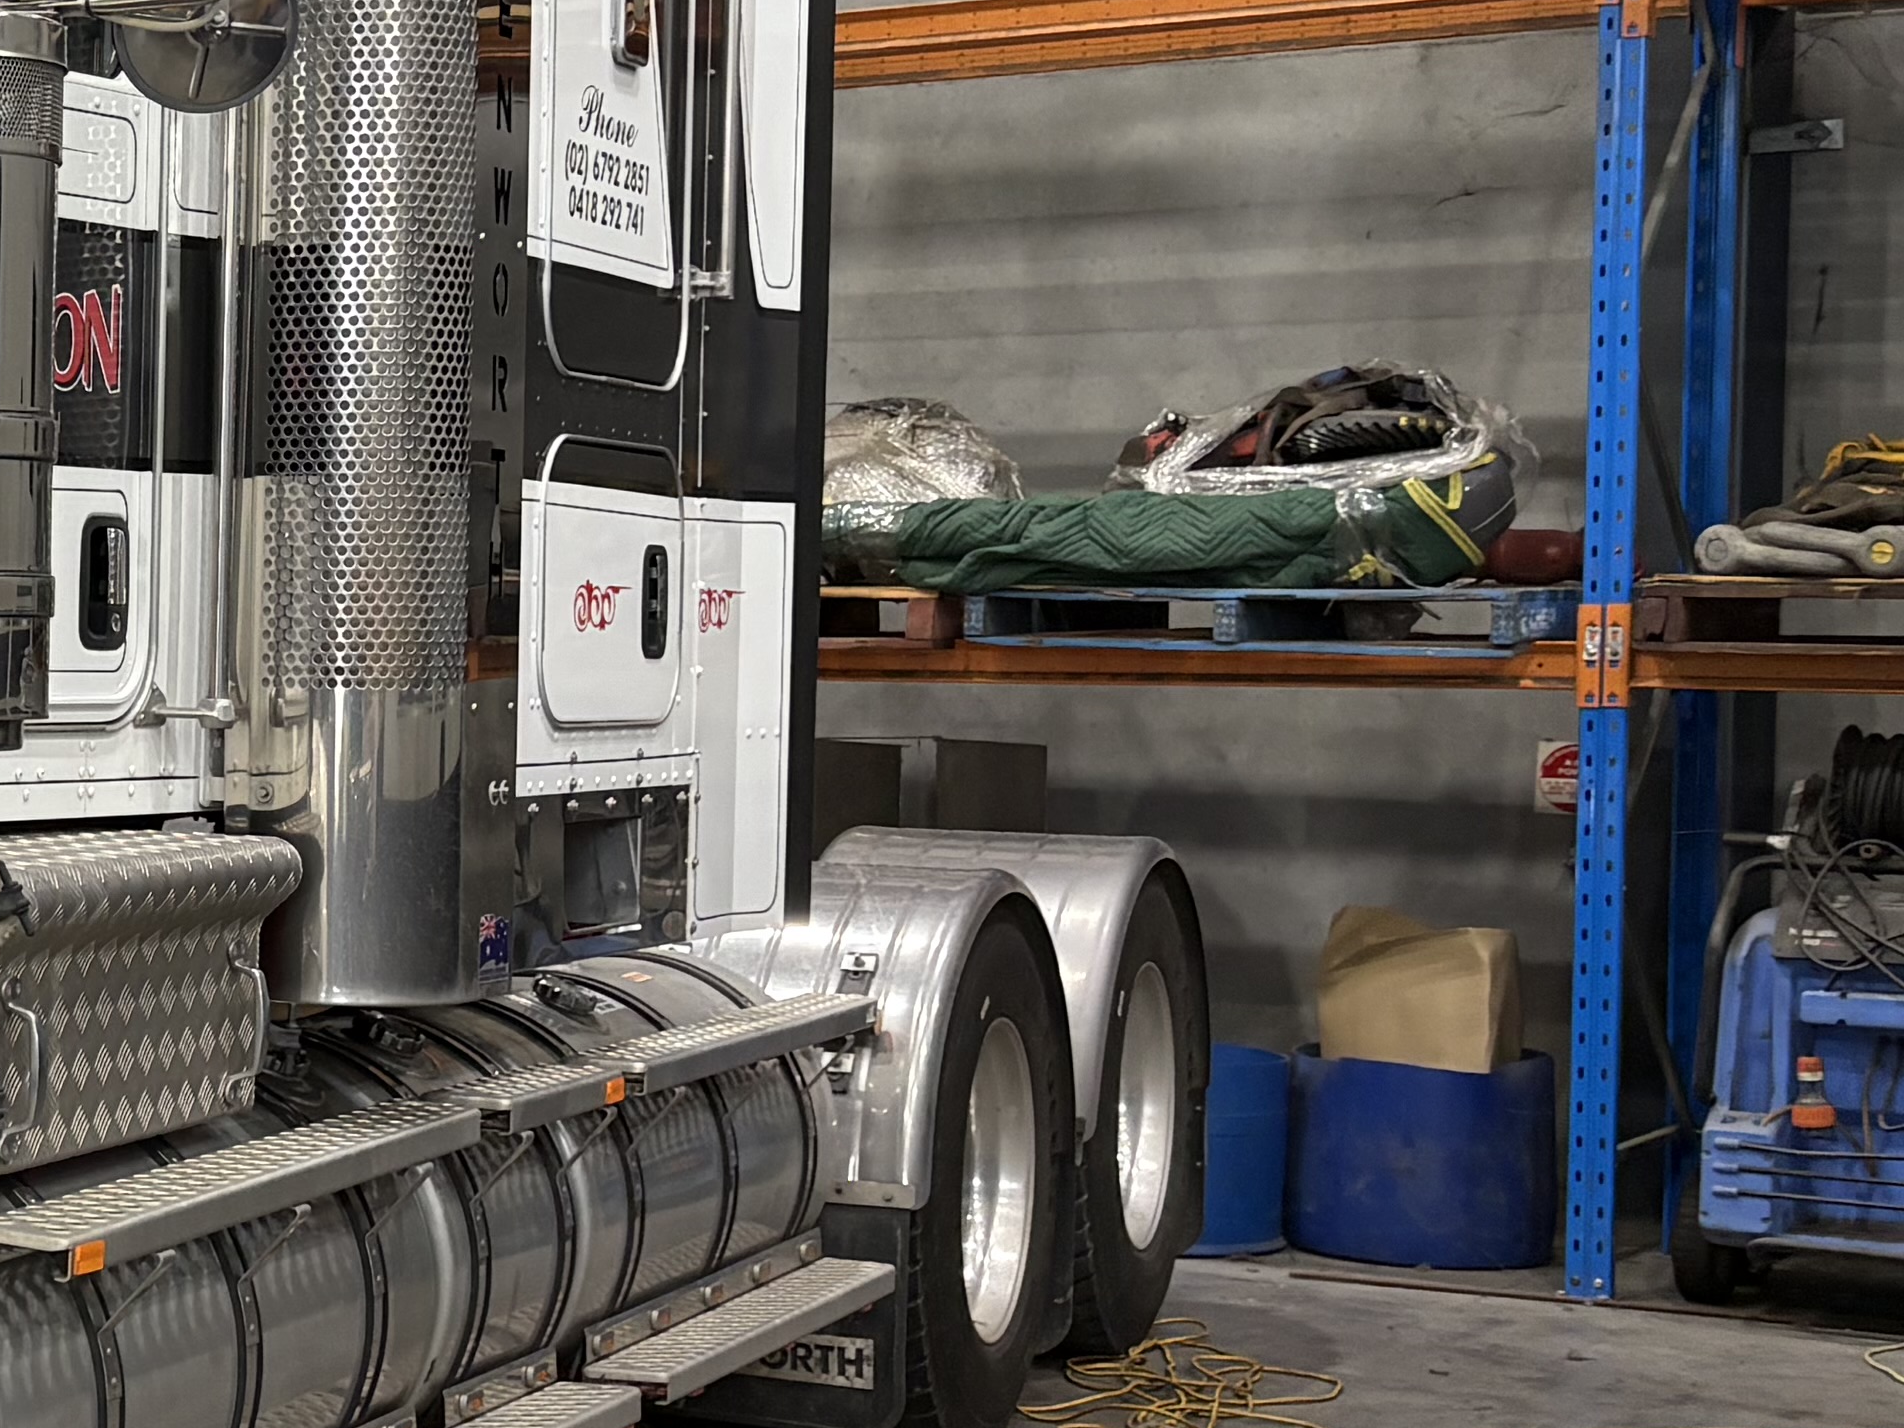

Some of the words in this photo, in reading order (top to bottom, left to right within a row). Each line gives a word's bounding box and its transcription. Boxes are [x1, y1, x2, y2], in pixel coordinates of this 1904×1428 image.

[579, 85, 639, 148] Phone
[565, 139, 589, 186] (02)
[593, 149, 620, 187] 6792
[624, 159, 649, 196] 2851
[568, 185, 598, 223] 0418
[602, 194, 622, 230] 292
[625, 202, 644, 236] 741
